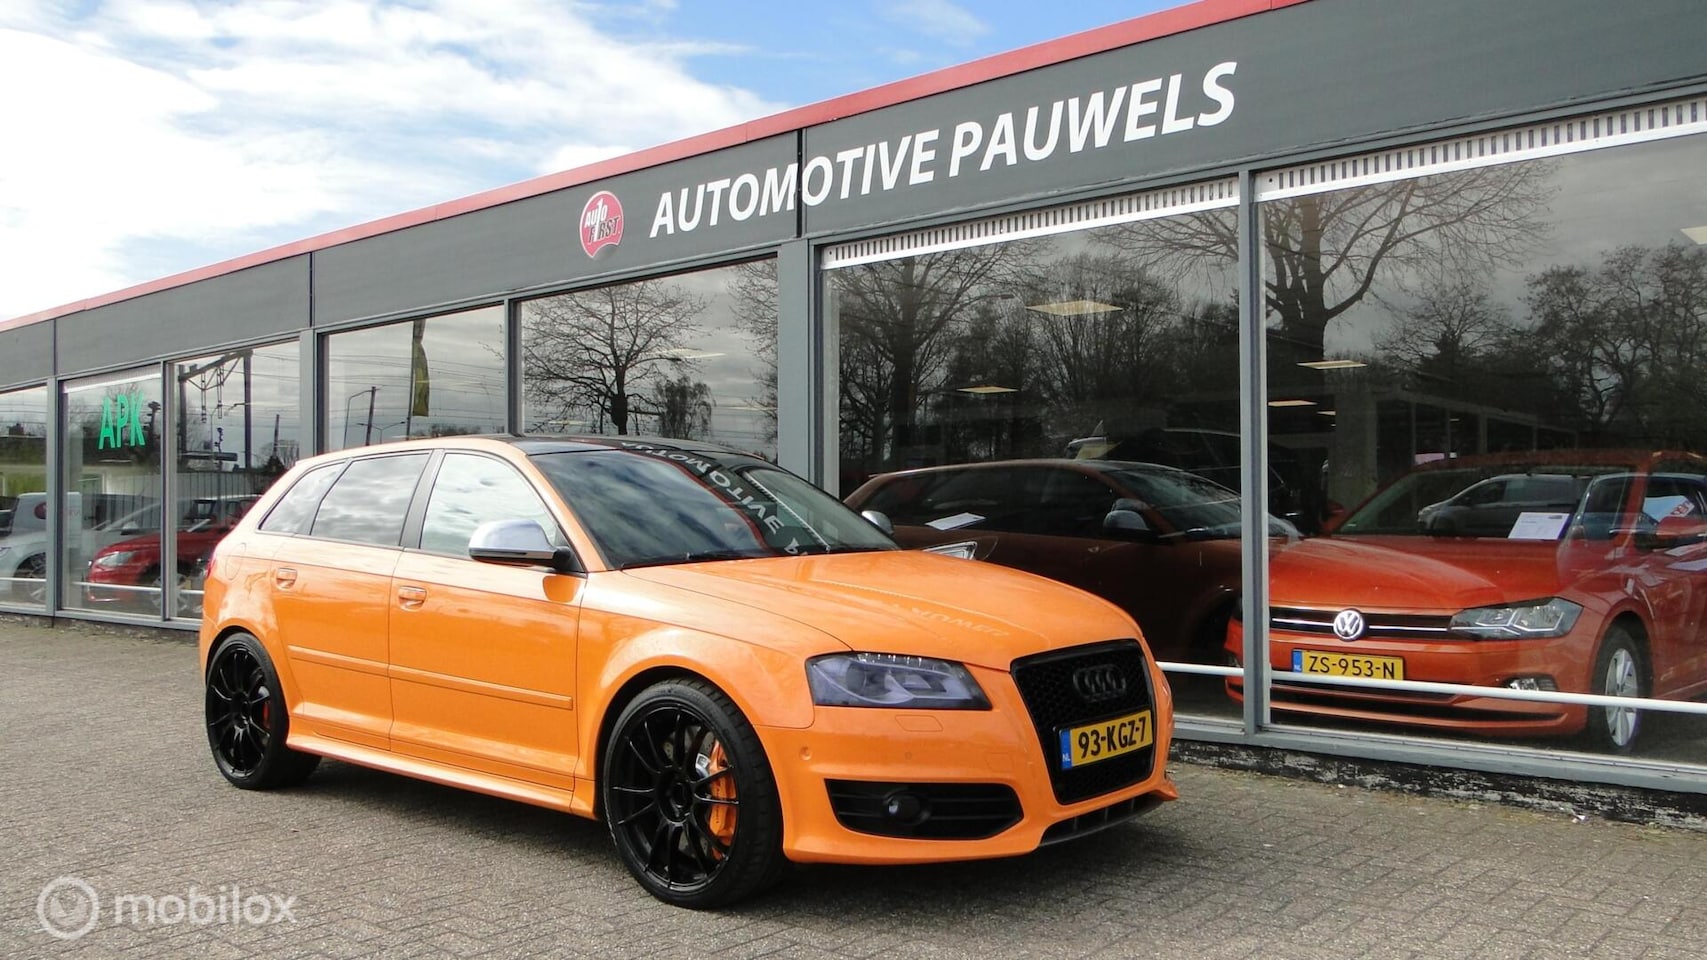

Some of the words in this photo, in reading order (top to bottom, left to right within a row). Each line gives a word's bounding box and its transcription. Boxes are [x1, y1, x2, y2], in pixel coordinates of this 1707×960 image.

[649, 129, 940, 239] AUTOMOTIVE
[947, 61, 1238, 178] PAUWELS
[98, 391, 146, 449] APK
[1308, 655, 1395, 680] ZS-953-N
[1078, 716, 1147, 759] 93-KGZ-7
